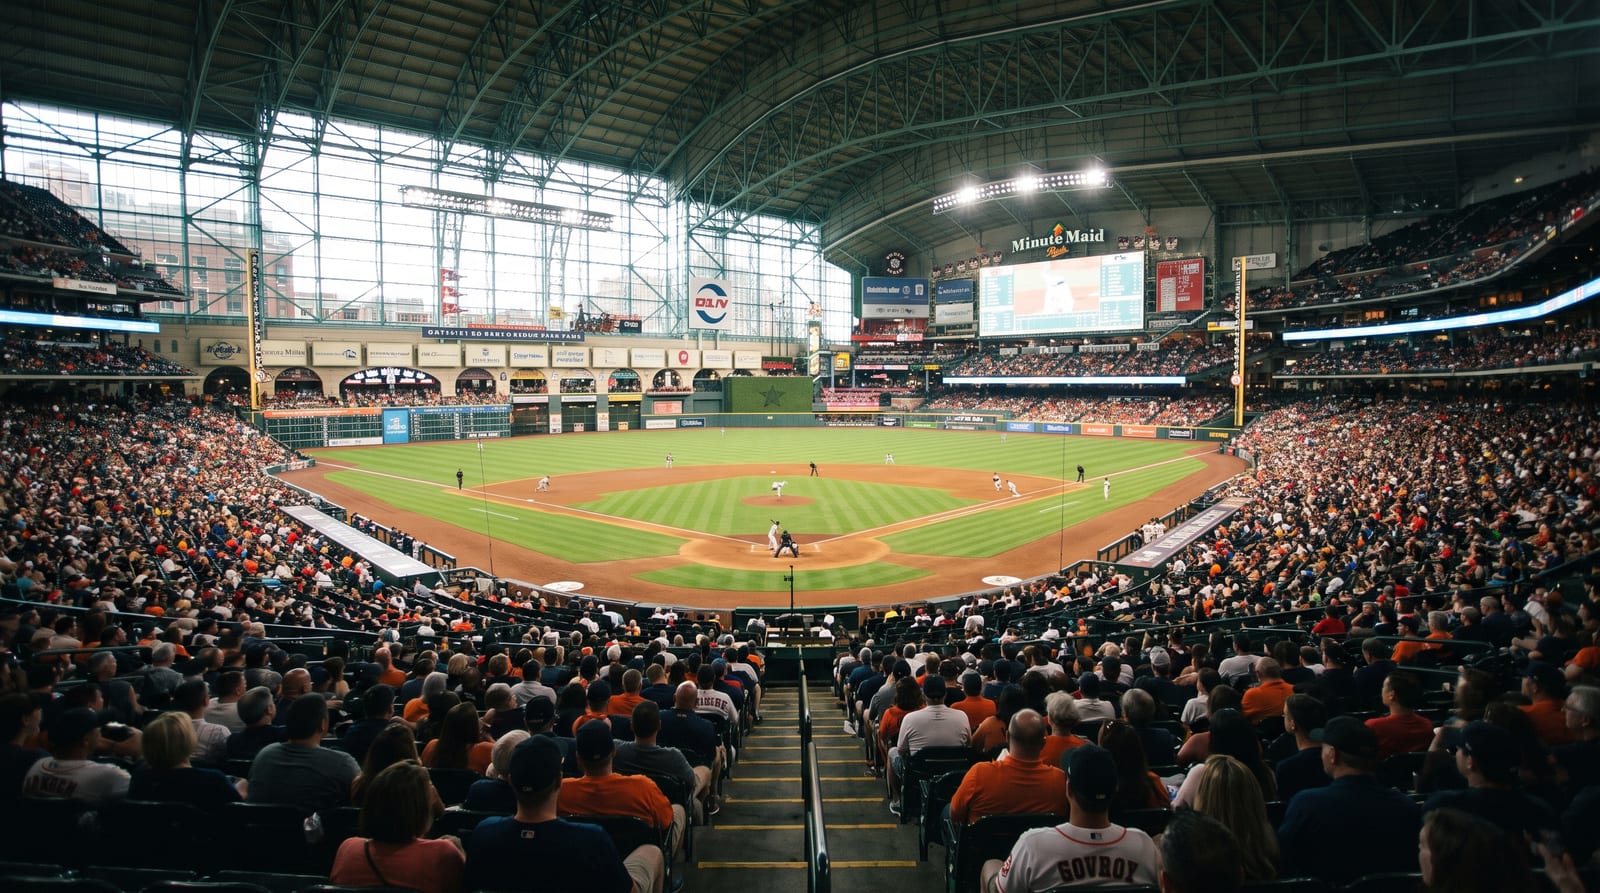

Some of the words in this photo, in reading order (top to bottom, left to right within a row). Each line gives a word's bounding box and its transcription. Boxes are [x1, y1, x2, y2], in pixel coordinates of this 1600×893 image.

[1011, 233, 1063, 253] Minute
[1066, 228, 1105, 243] Maid
[1057, 855, 1139, 883] GOVROY
